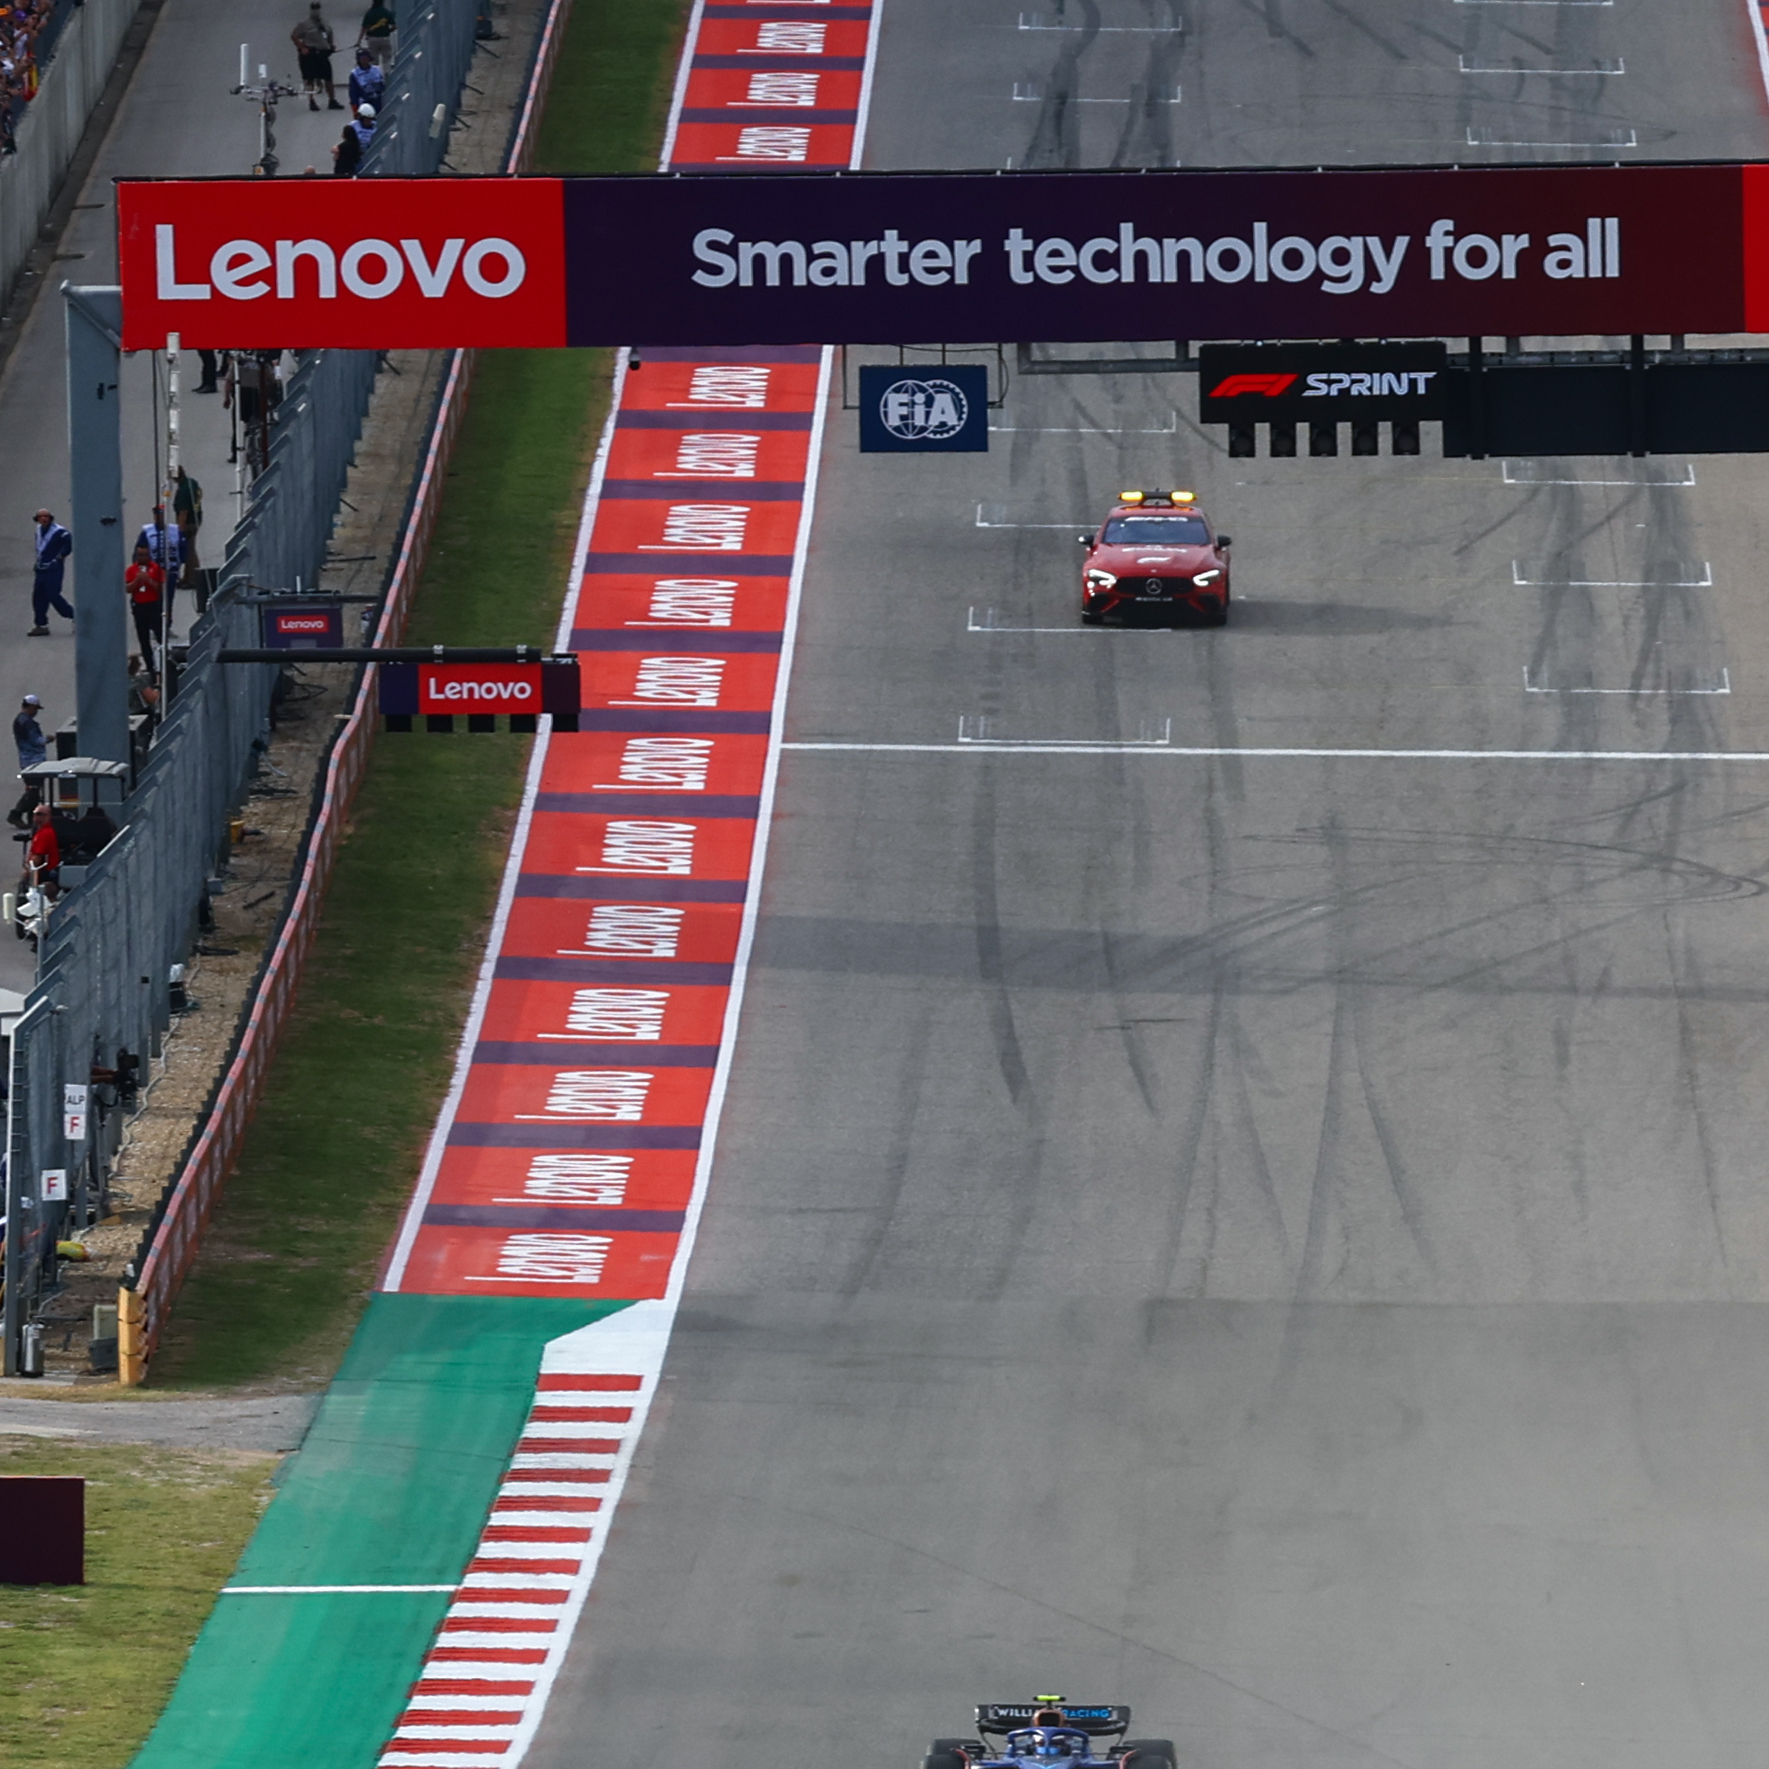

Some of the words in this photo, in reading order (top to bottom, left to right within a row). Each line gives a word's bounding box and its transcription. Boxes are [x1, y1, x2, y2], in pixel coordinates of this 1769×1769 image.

[155, 224, 526, 300] Lenovo
[691, 228, 981, 287] Smarter
[1004, 221, 1410, 294] technology
[1425, 219, 1529, 280] for
[1544, 217, 1620, 279] all
[1301, 371, 1437, 396] SPRINT
[281, 619, 324, 630] Lenovo
[429, 677, 532, 701] Lenovo
[69, 1116, 80, 1133] F
[47, 1176, 58, 1194] F
